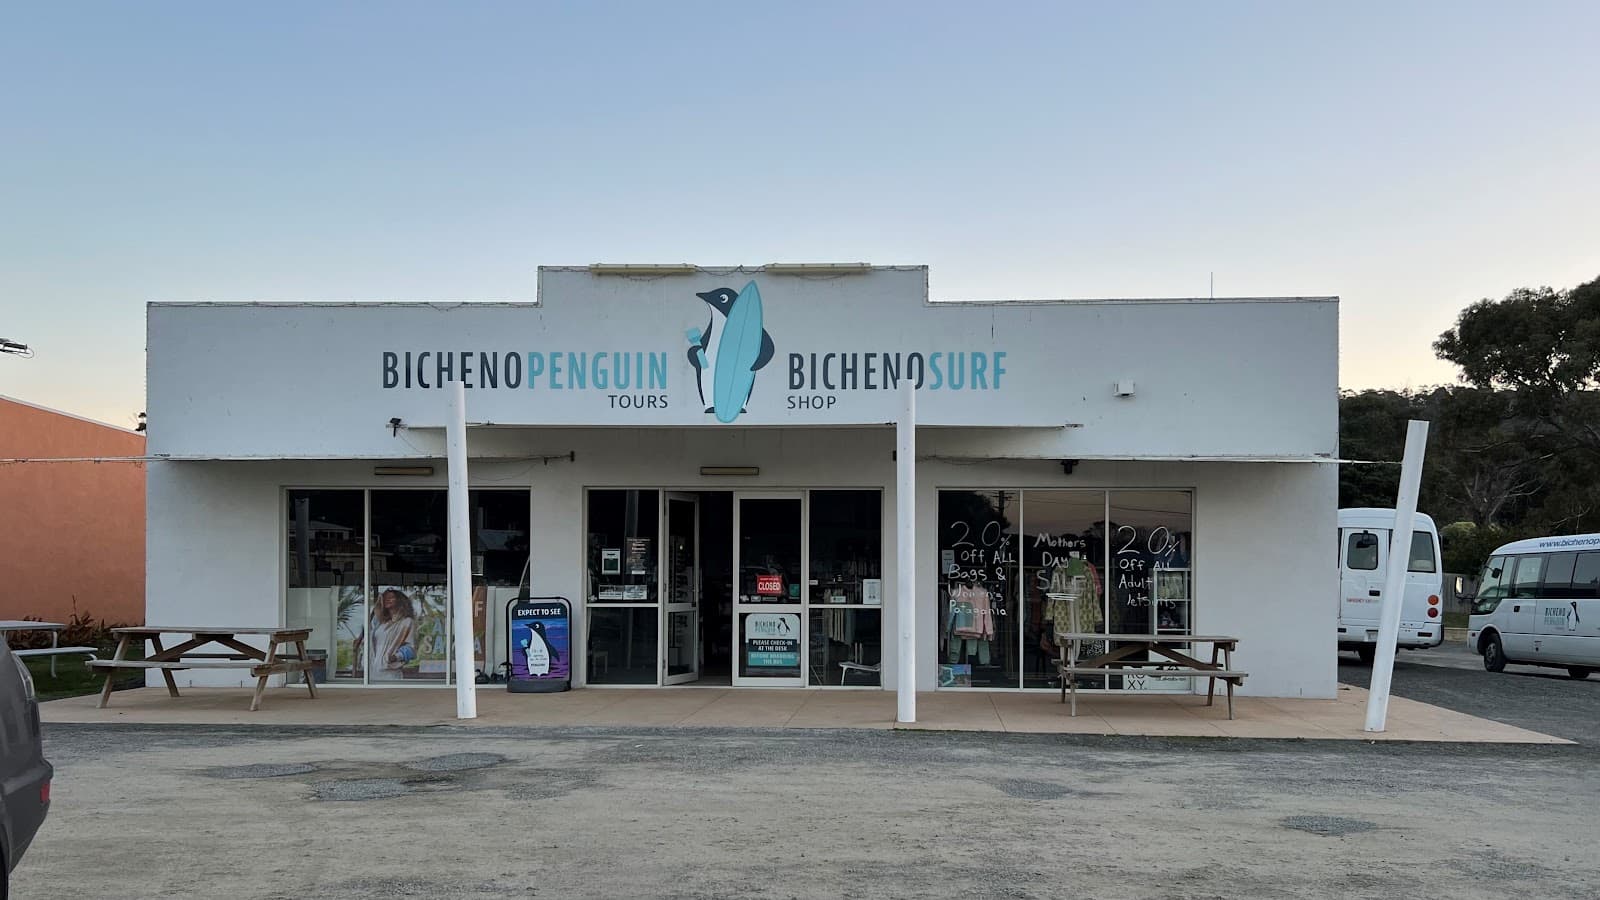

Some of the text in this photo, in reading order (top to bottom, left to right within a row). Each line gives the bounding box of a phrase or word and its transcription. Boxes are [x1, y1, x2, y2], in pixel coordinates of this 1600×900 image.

[608, 394, 669, 409] TOURS
[787, 395, 837, 410] SHOP
[1033, 533, 1087, 549] Mothers
[947, 563, 1007, 582] Bags &
[758, 582, 781, 591] CLOSED
[1036, 570, 1087, 593] SALE
[1118, 573, 1154, 590] Adult
[518, 609, 540, 617] EXPECT
[550, 608, 561, 616] SEE
